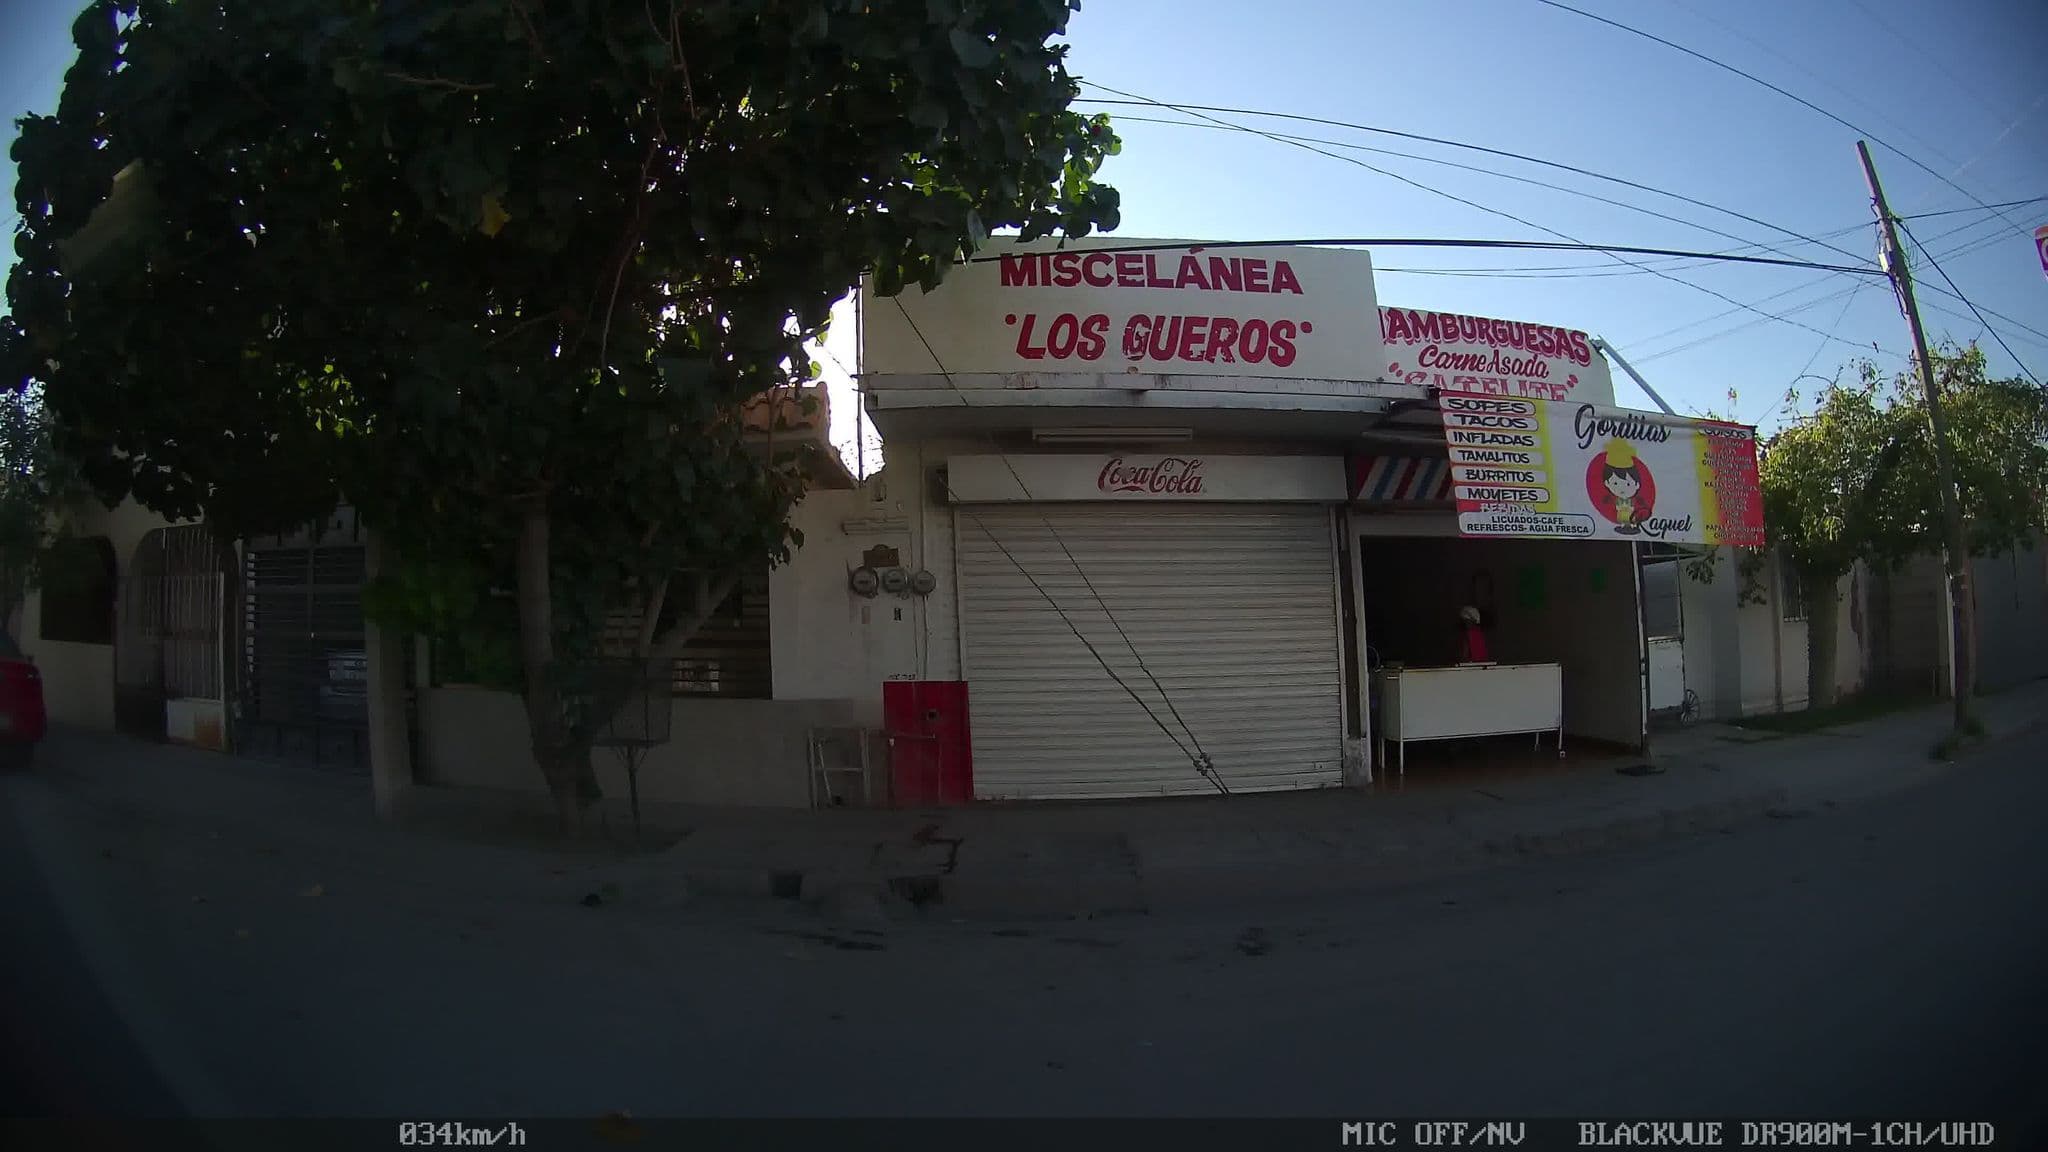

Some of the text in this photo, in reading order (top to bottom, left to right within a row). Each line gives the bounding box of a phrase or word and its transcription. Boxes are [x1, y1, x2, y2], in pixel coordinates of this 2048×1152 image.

[1000, 246, 1304, 295] MISCELÁNEA
[1016, 313, 1297, 367] LOS GUEROS
[1378, 306, 1591, 367] AMBURGUESAS
[1418, 345, 1549, 379] Carne Asada
[1448, 399, 1527, 414] SOPES
[1453, 414, 1528, 428] TACOS
[1574, 404, 1671, 449] Gorditas
[1454, 431, 1534, 446] INFLADAS
[1457, 450, 1530, 463] TAMALITOS
[1466, 469, 1535, 483] BURRITOS
[1529, 525, 1553, 533] AGUA
[1556, 526, 1589, 534] FRESCA
